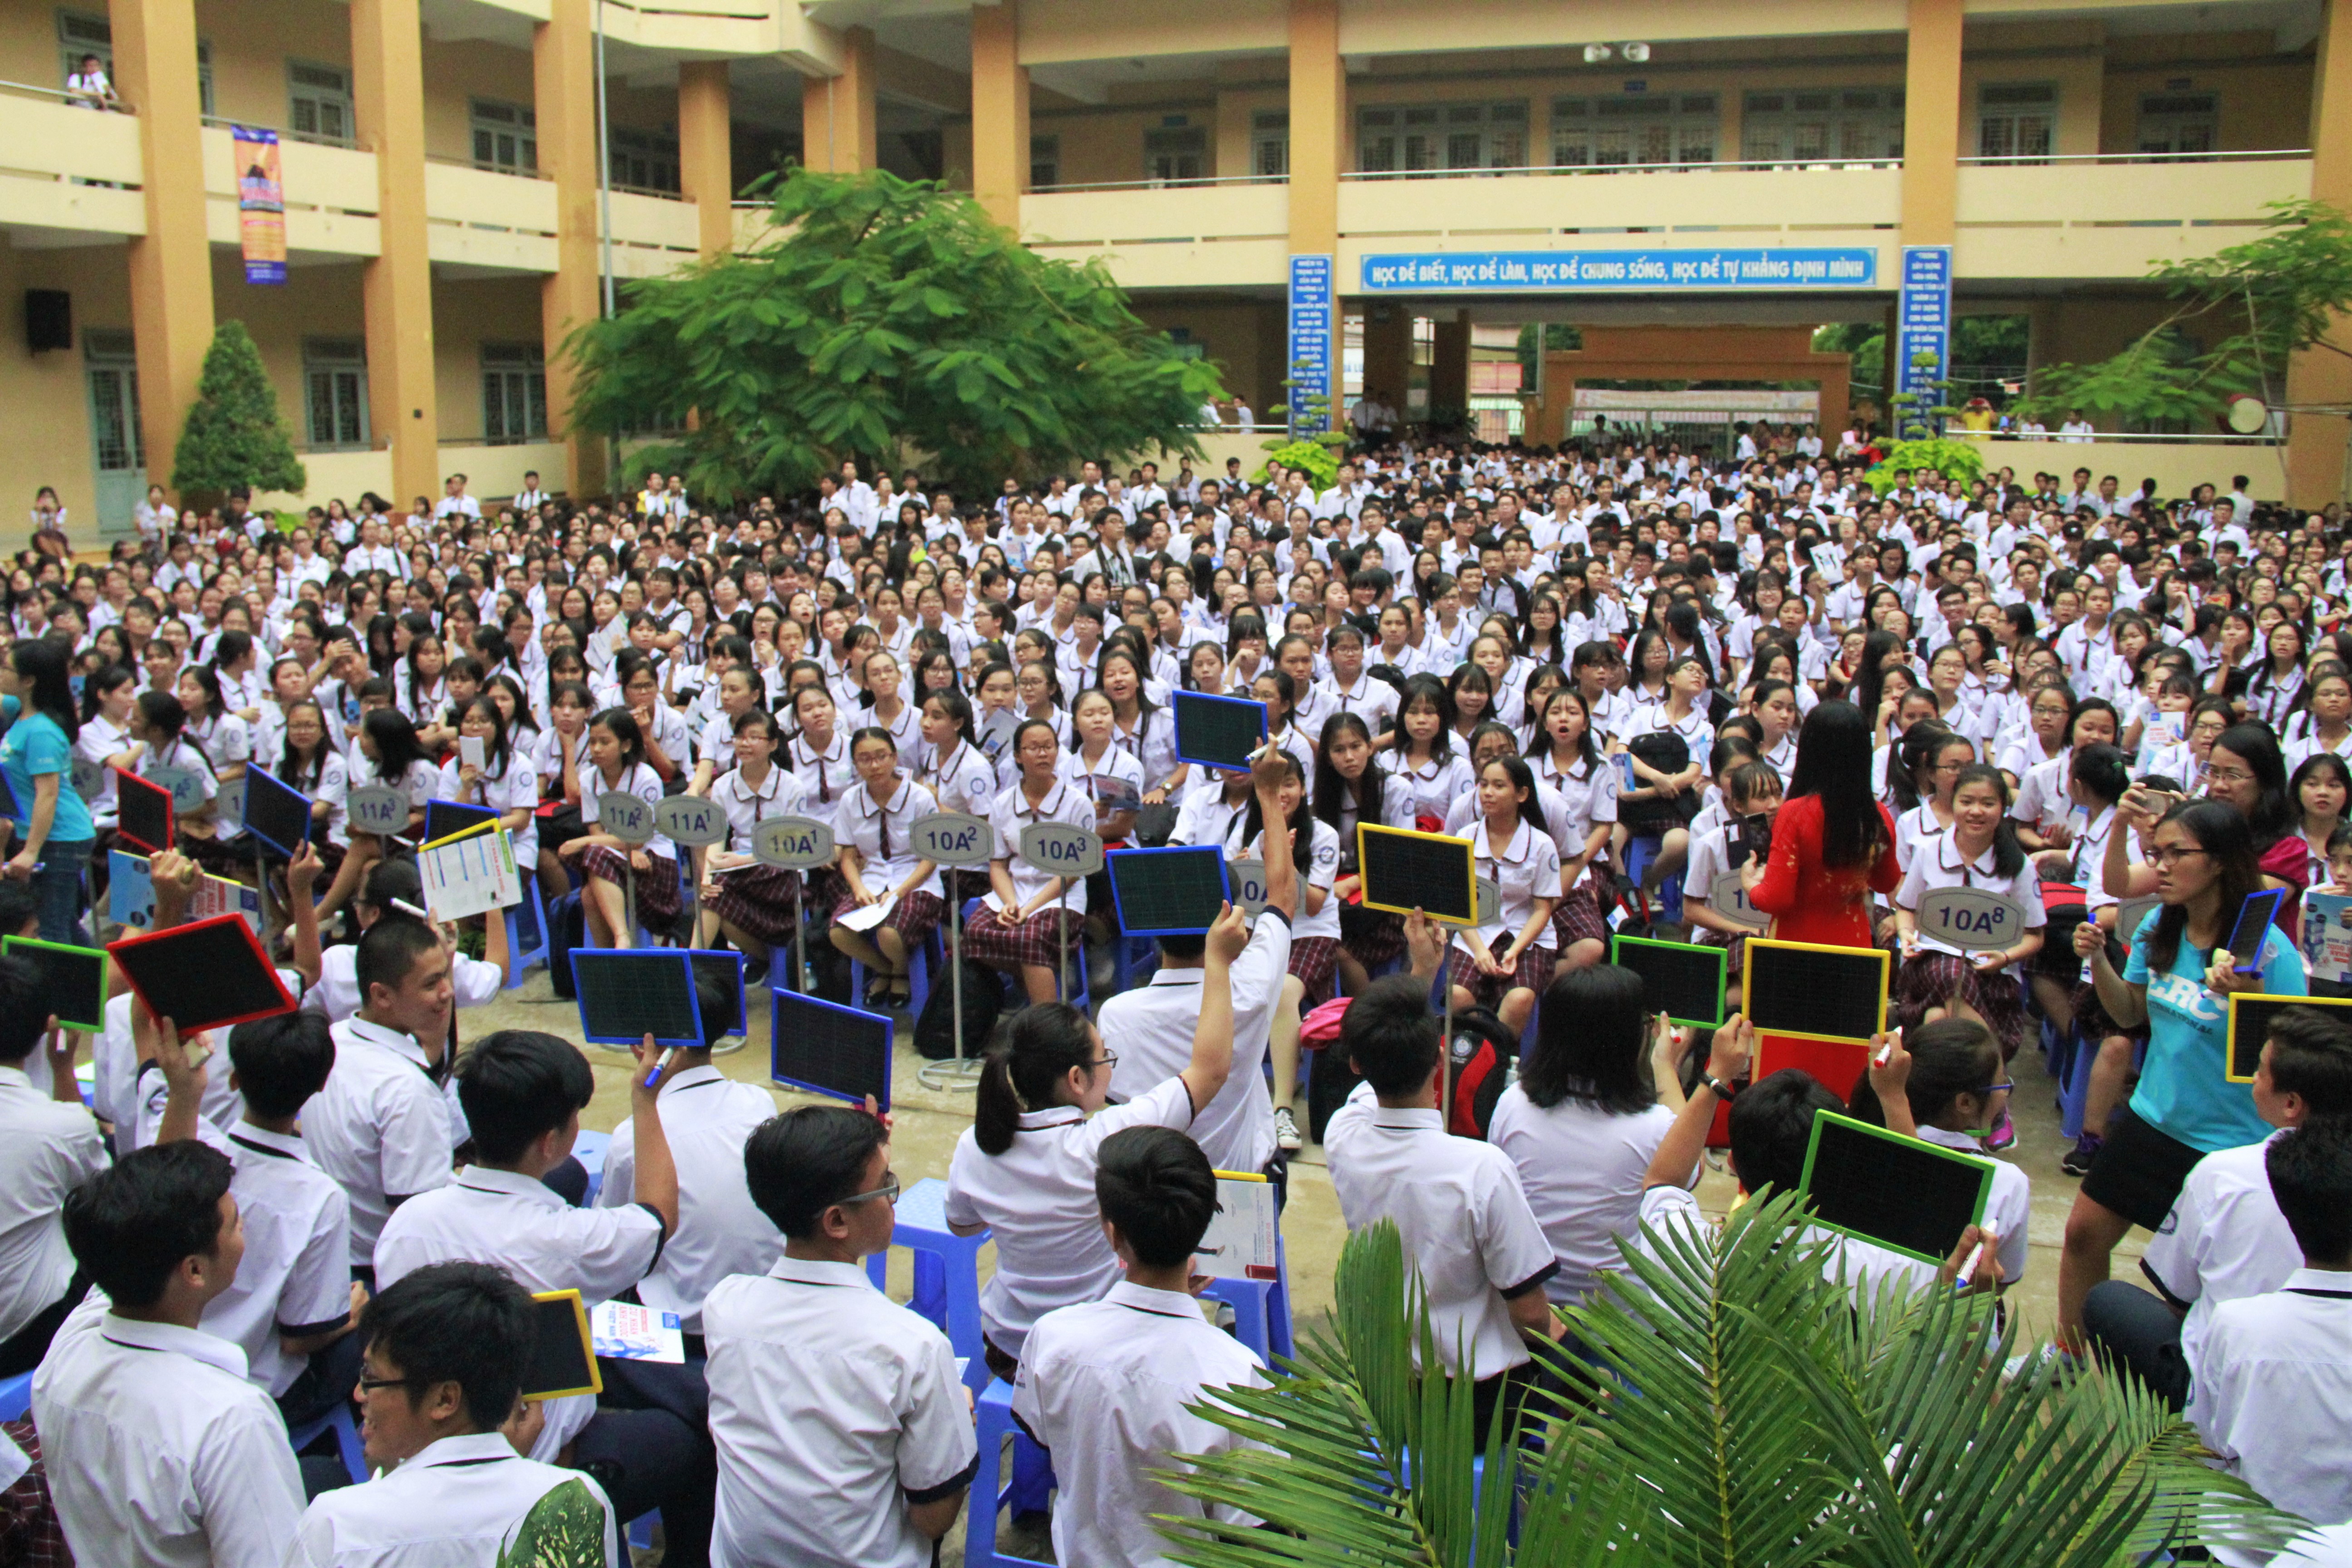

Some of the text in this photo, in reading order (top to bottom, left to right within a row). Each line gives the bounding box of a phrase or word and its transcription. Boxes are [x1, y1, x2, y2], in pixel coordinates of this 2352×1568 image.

[1373, 266, 1395, 287] HỌC
[1420, 259, 1448, 284] BIẾT,
[1453, 265, 1476, 285] HỌC
[1500, 260, 1528, 282] LÀM,
[1533, 264, 1556, 284] HỌC
[1581, 263, 1625, 279] CHUNG
[1629, 255, 1668, 281] SỐNG,
[1672, 262, 1697, 283] HỌC
[1723, 260, 1740, 283] TỰ
[1793, 260, 1826, 282] ĐỊNH
[1829, 257, 1864, 278] MÌNH
